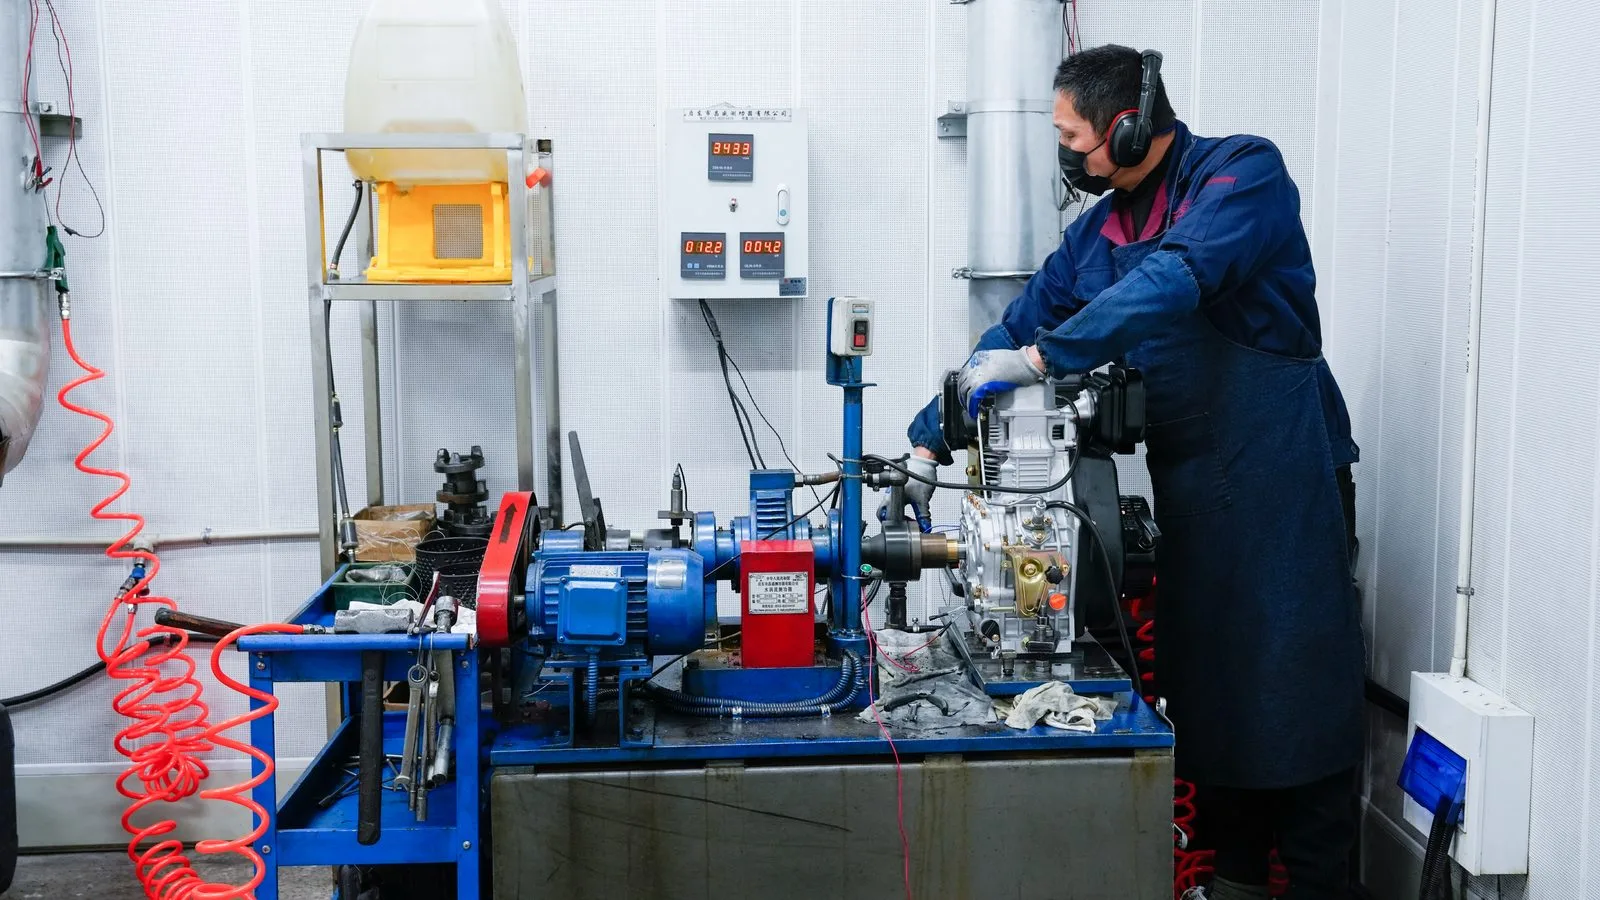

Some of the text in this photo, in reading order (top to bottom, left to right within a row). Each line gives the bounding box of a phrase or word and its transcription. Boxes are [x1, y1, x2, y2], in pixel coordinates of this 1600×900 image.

[713, 142, 750, 155] 3433
[685, 240, 723, 254] 012.2
[744, 240, 782, 253] 004.2
